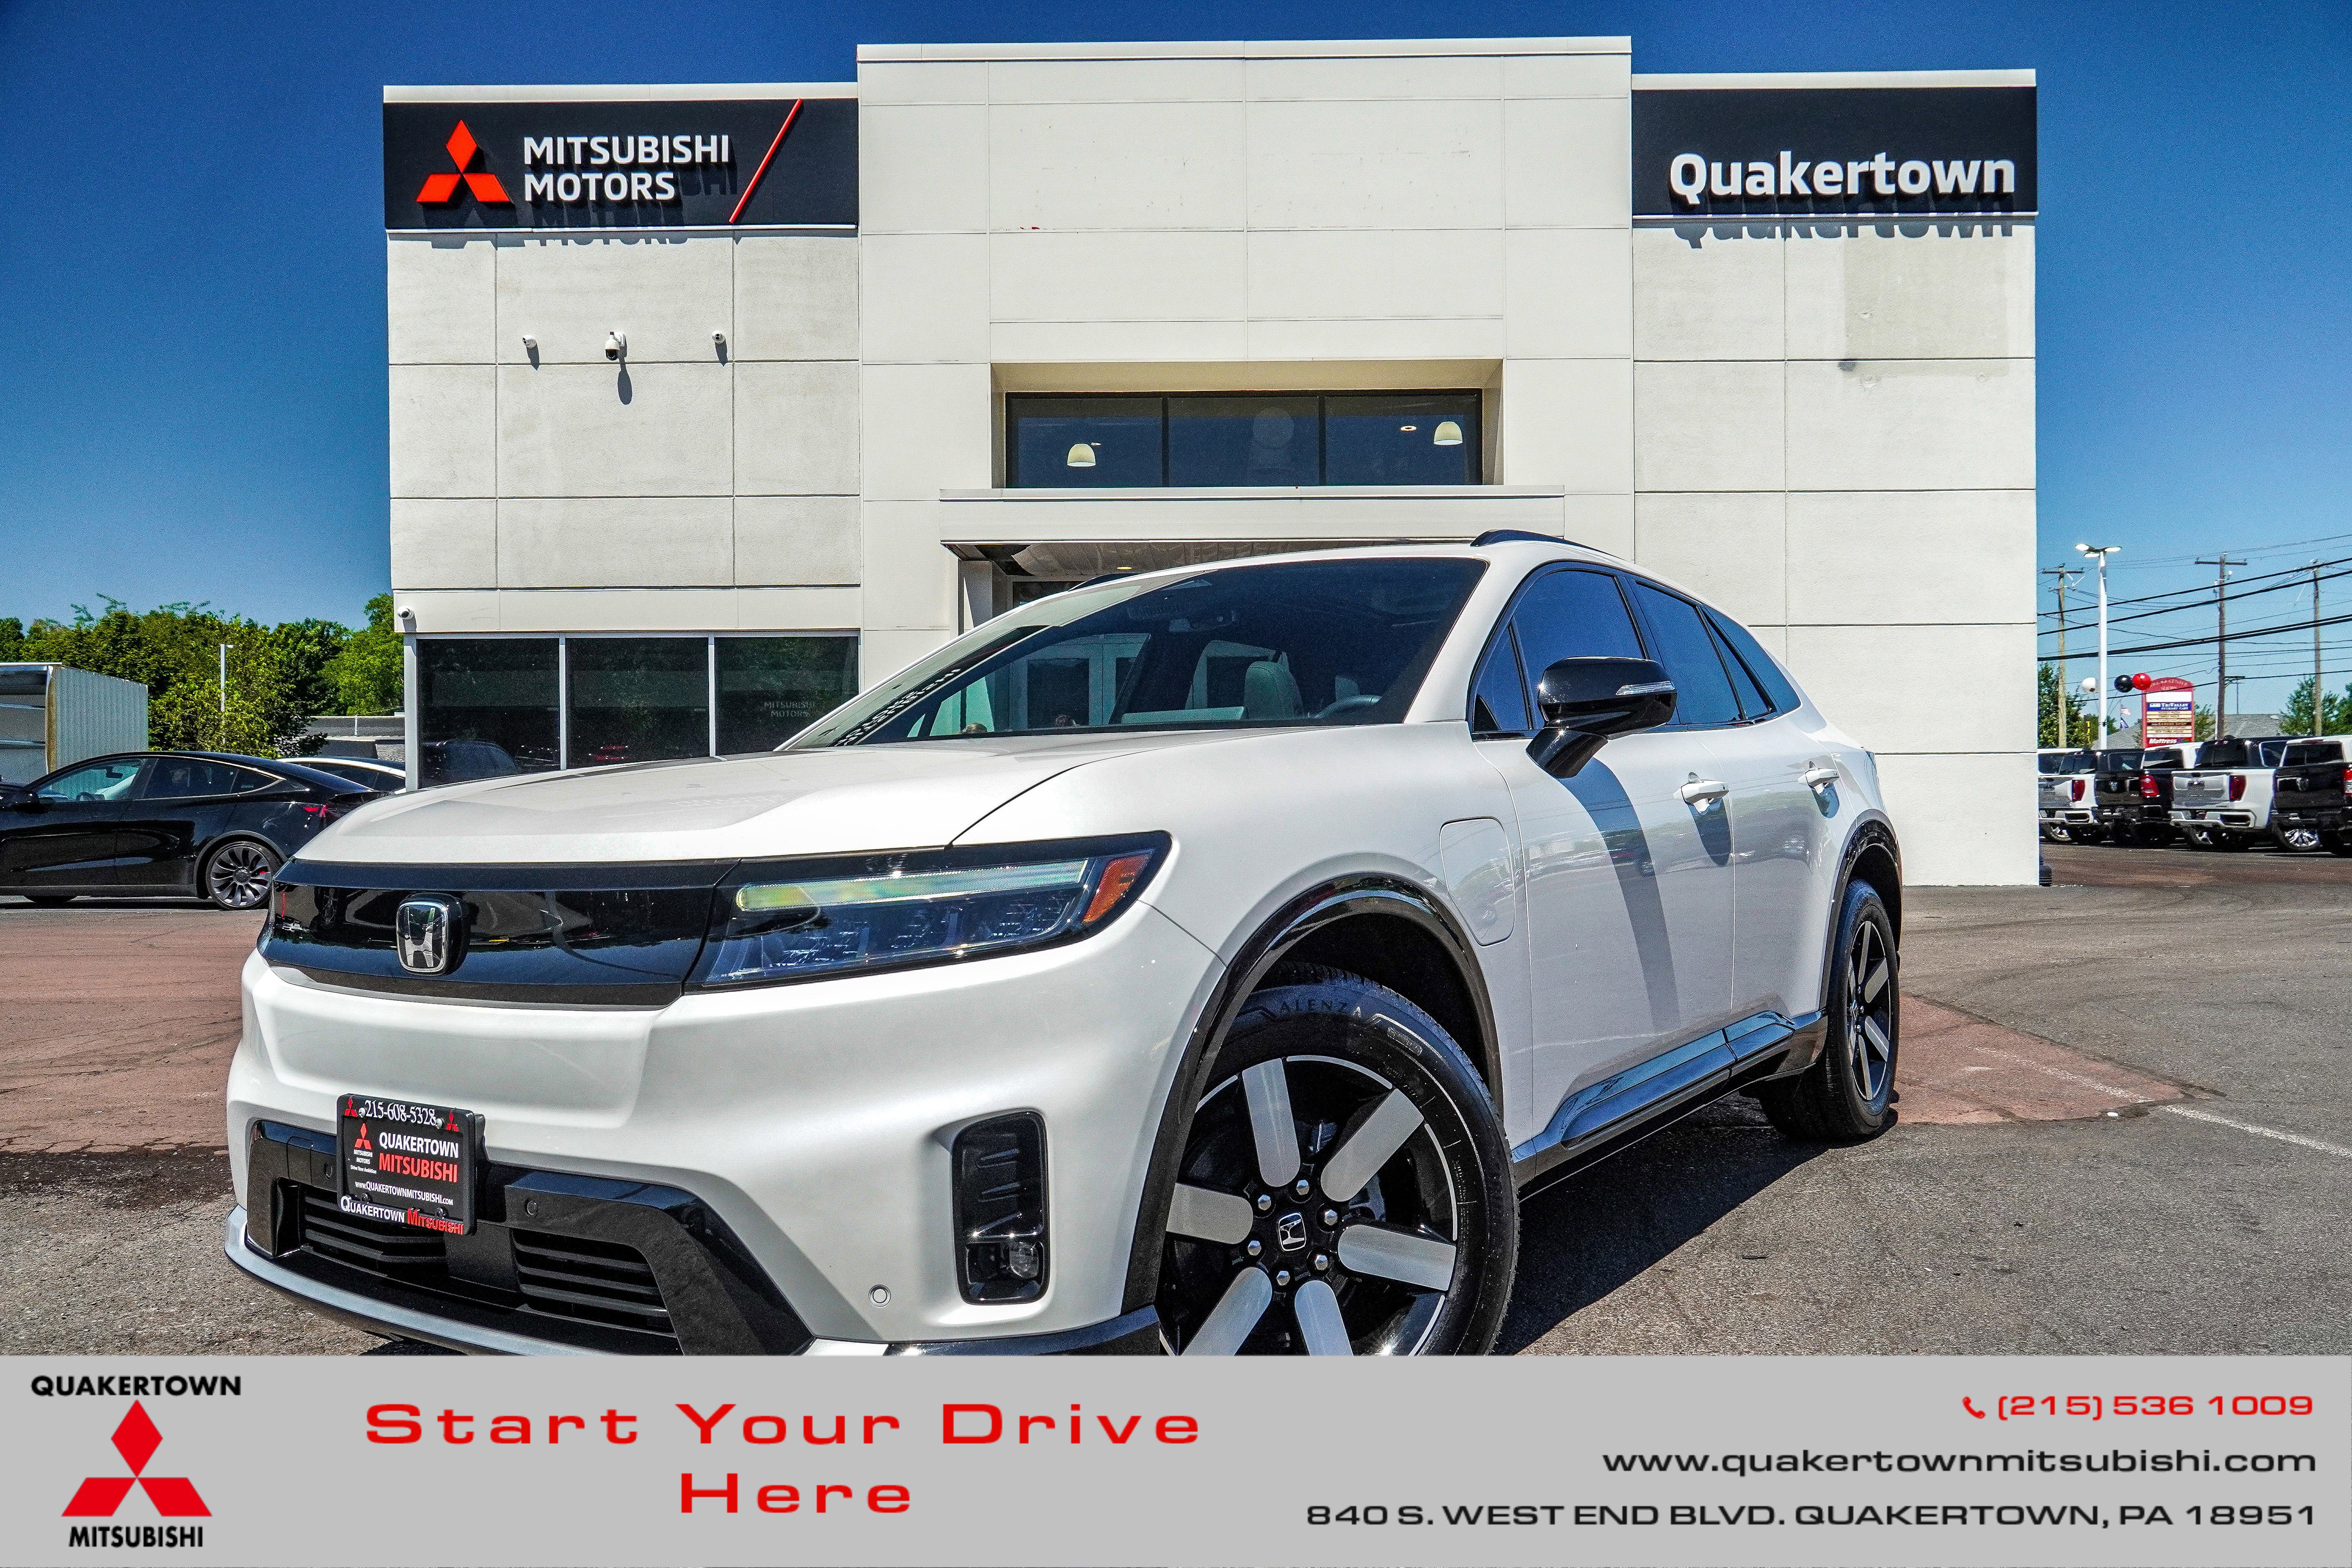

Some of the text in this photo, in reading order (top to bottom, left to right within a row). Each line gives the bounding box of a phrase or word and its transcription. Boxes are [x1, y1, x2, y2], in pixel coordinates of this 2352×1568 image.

[523, 134, 729, 165] MITSUBISHI
[524, 172, 676, 203] MOTORS
[1669, 150, 2016, 205] Quakertown
[365, 1100, 436, 1126] 215-608-5328
[354, 1149, 373, 1158] MITSUBISHI
[379, 1132, 459, 1158] QUAKERTOWN
[379, 1152, 458, 1183] MITSUBISHI
